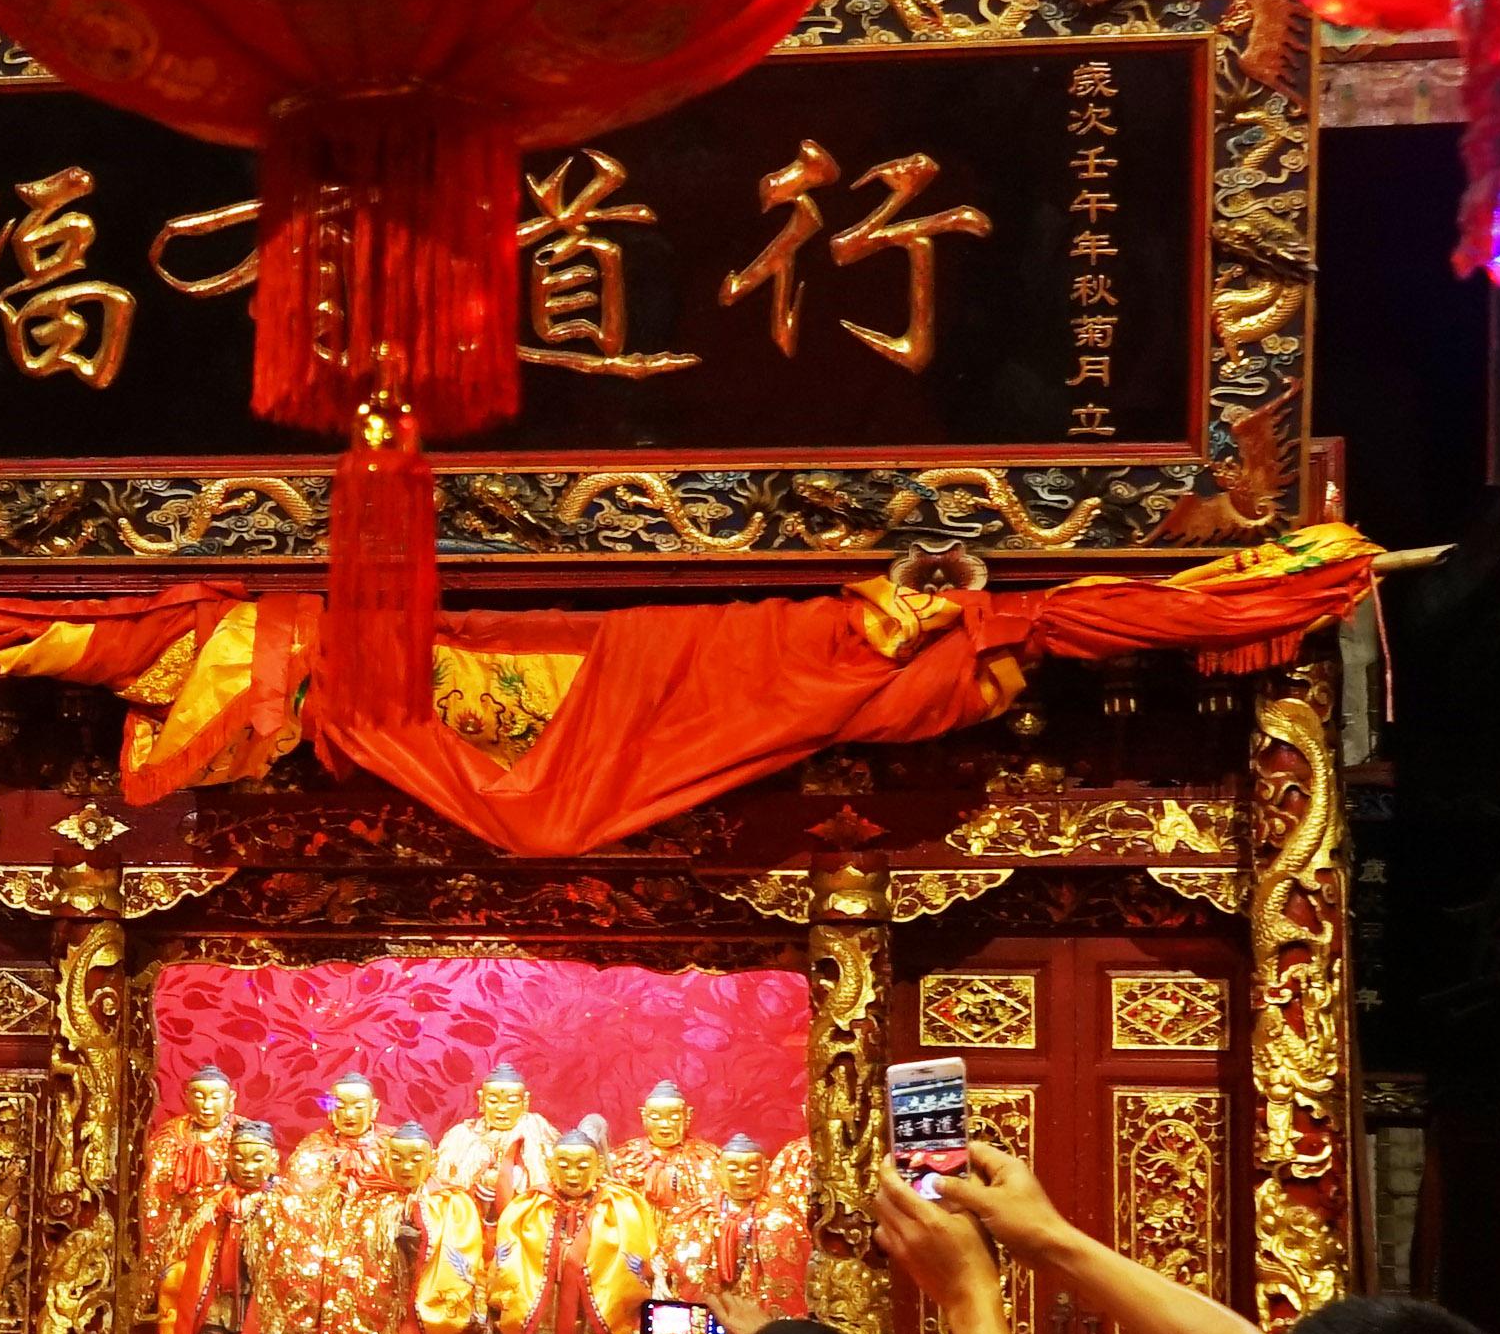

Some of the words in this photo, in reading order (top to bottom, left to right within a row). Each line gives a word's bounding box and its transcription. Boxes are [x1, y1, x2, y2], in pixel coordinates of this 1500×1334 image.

[1066, 60, 1120, 439] 歲次壬午年秋菊月立
